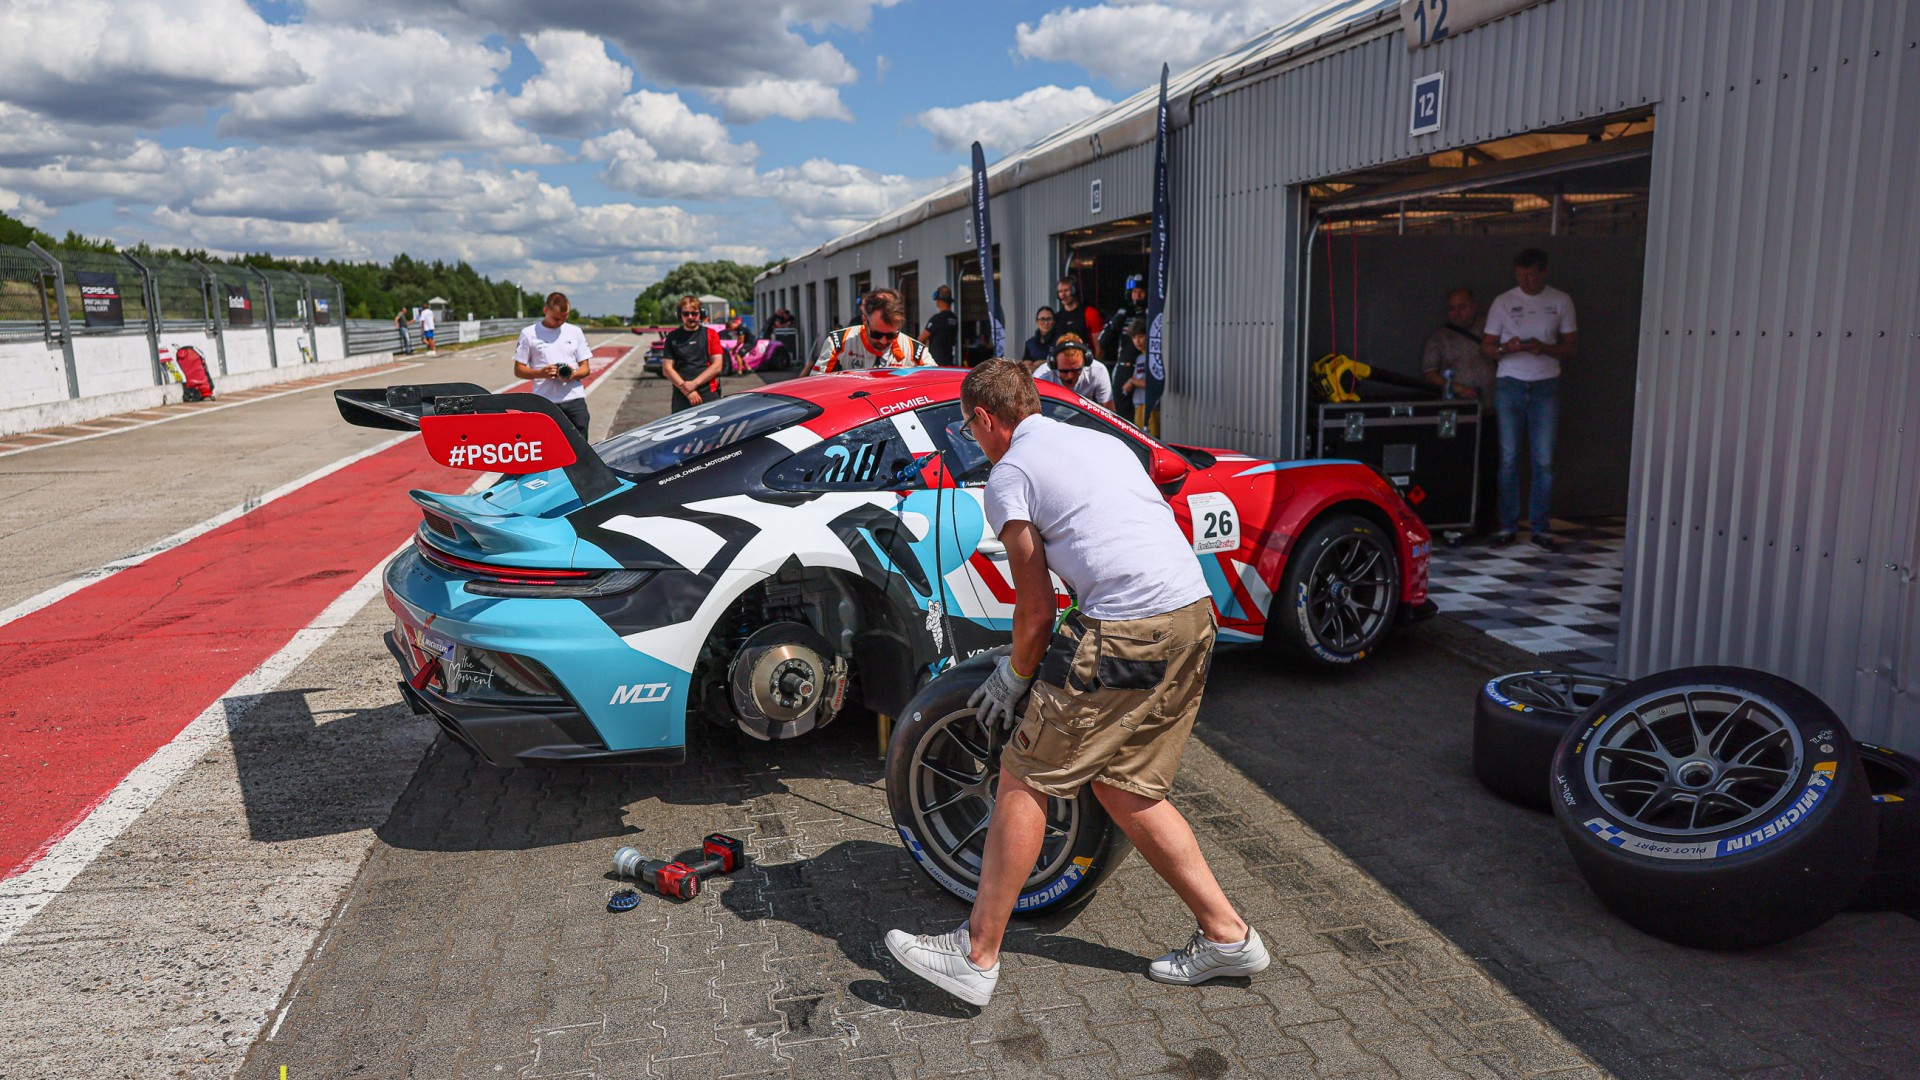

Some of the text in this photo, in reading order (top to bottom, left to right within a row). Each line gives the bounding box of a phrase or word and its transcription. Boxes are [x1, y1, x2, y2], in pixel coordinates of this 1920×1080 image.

[1414, 0, 1448, 47] 12
[1419, 92, 1434, 117] 12
[1089, 133, 1103, 158] 13
[880, 396, 934, 415] CHMIEL
[449, 440, 542, 467] #PSCCE
[1204, 510, 1233, 539] 26
[425, 639, 449, 653] MICHELIN
[448, 663, 494, 689] Moment
[1727, 788, 1820, 852] MICHELIN
[1633, 842, 1707, 855] PILOT SPORT
[928, 867, 953, 888] SPORT
